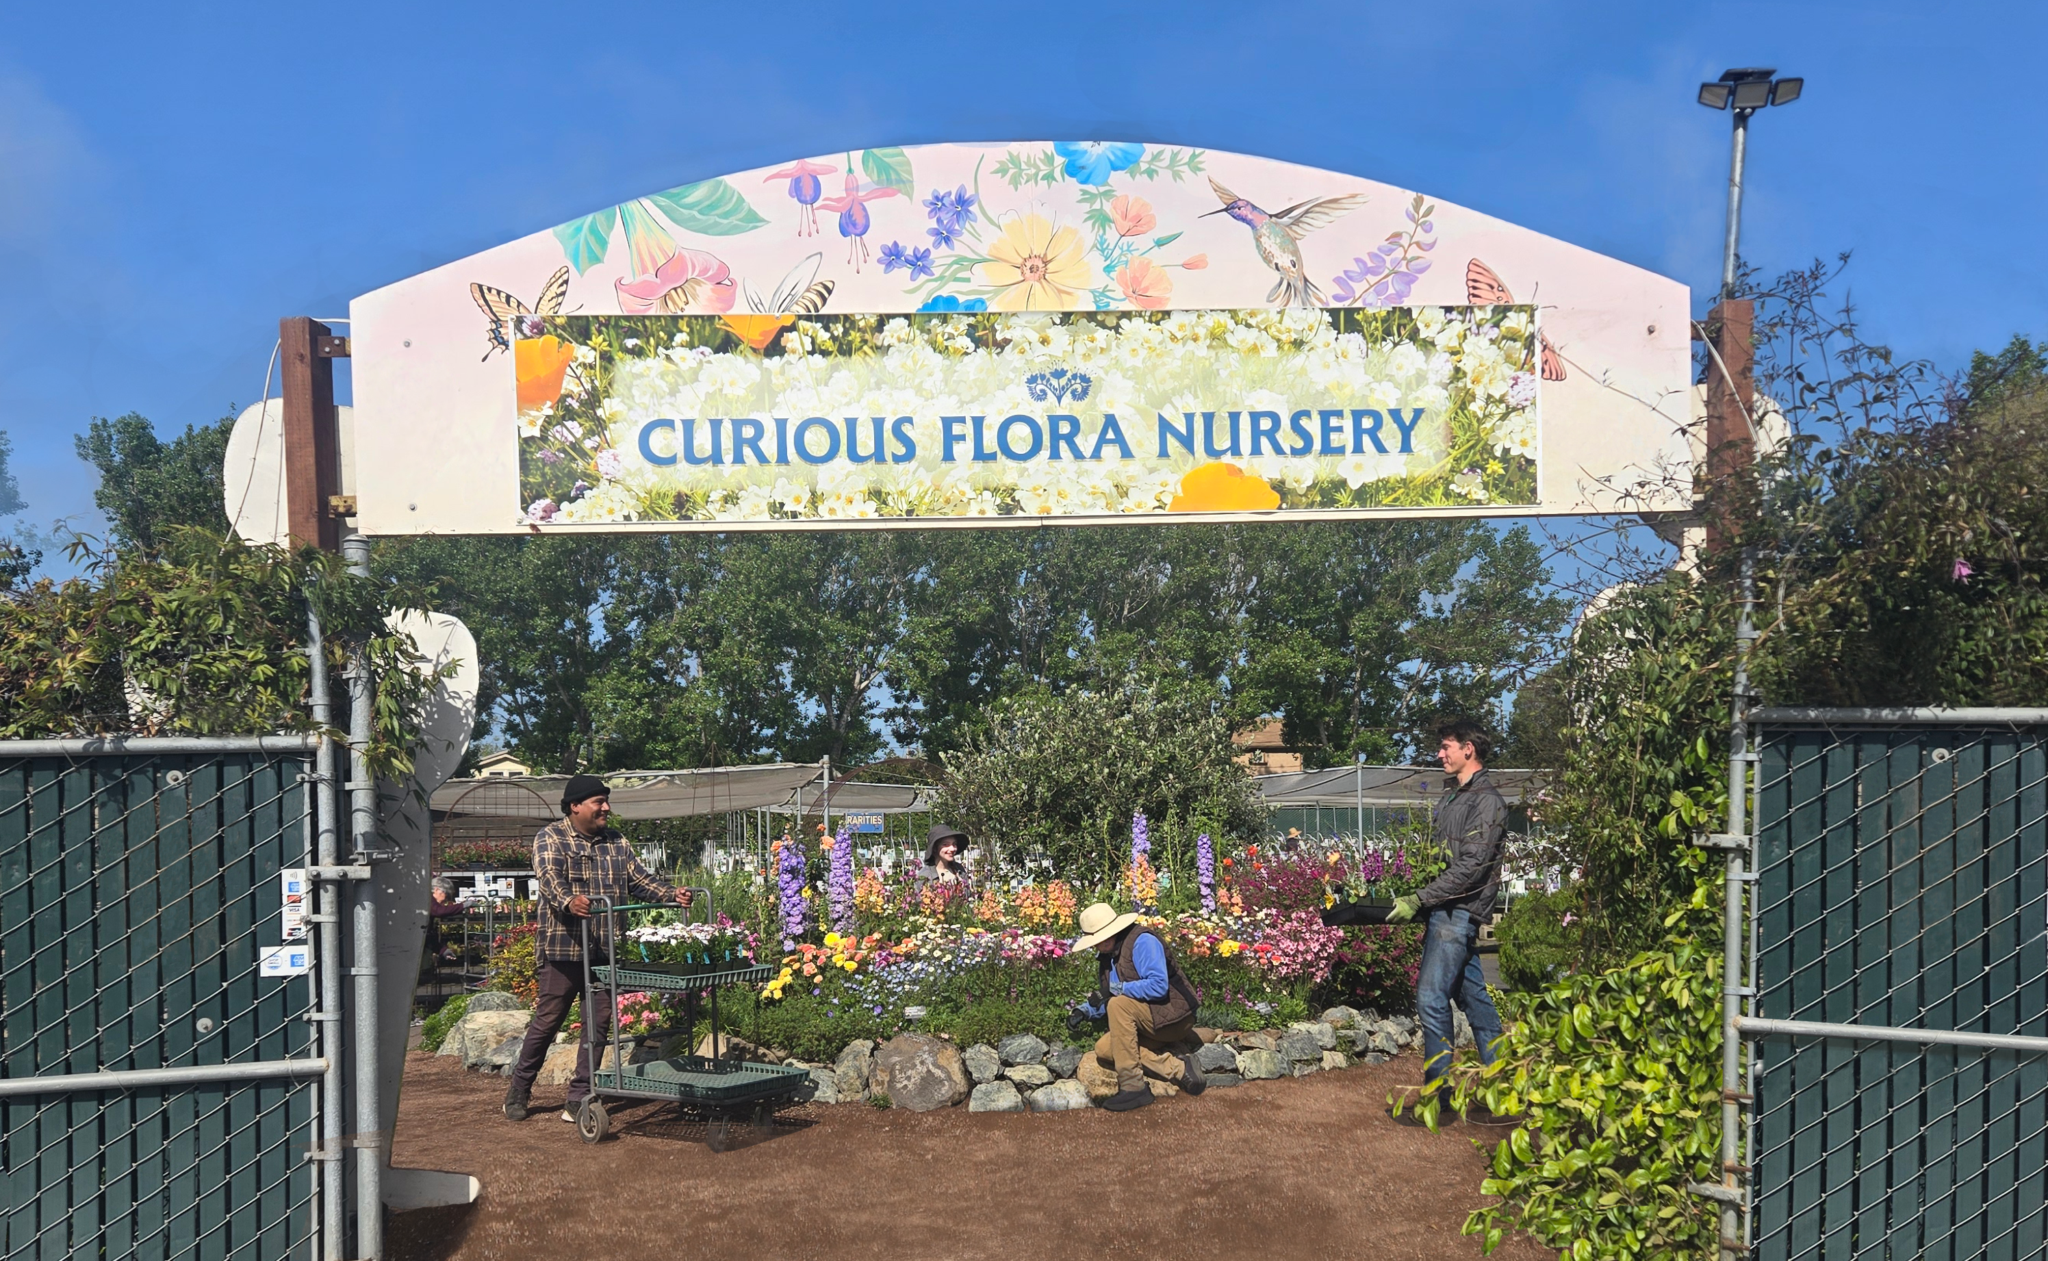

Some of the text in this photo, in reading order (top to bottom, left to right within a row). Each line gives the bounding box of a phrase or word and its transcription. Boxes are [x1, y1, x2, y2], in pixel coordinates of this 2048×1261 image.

[637, 408, 1426, 465] CURIOUS FLORA NURSERY
[847, 815, 883, 825] RARITIES
